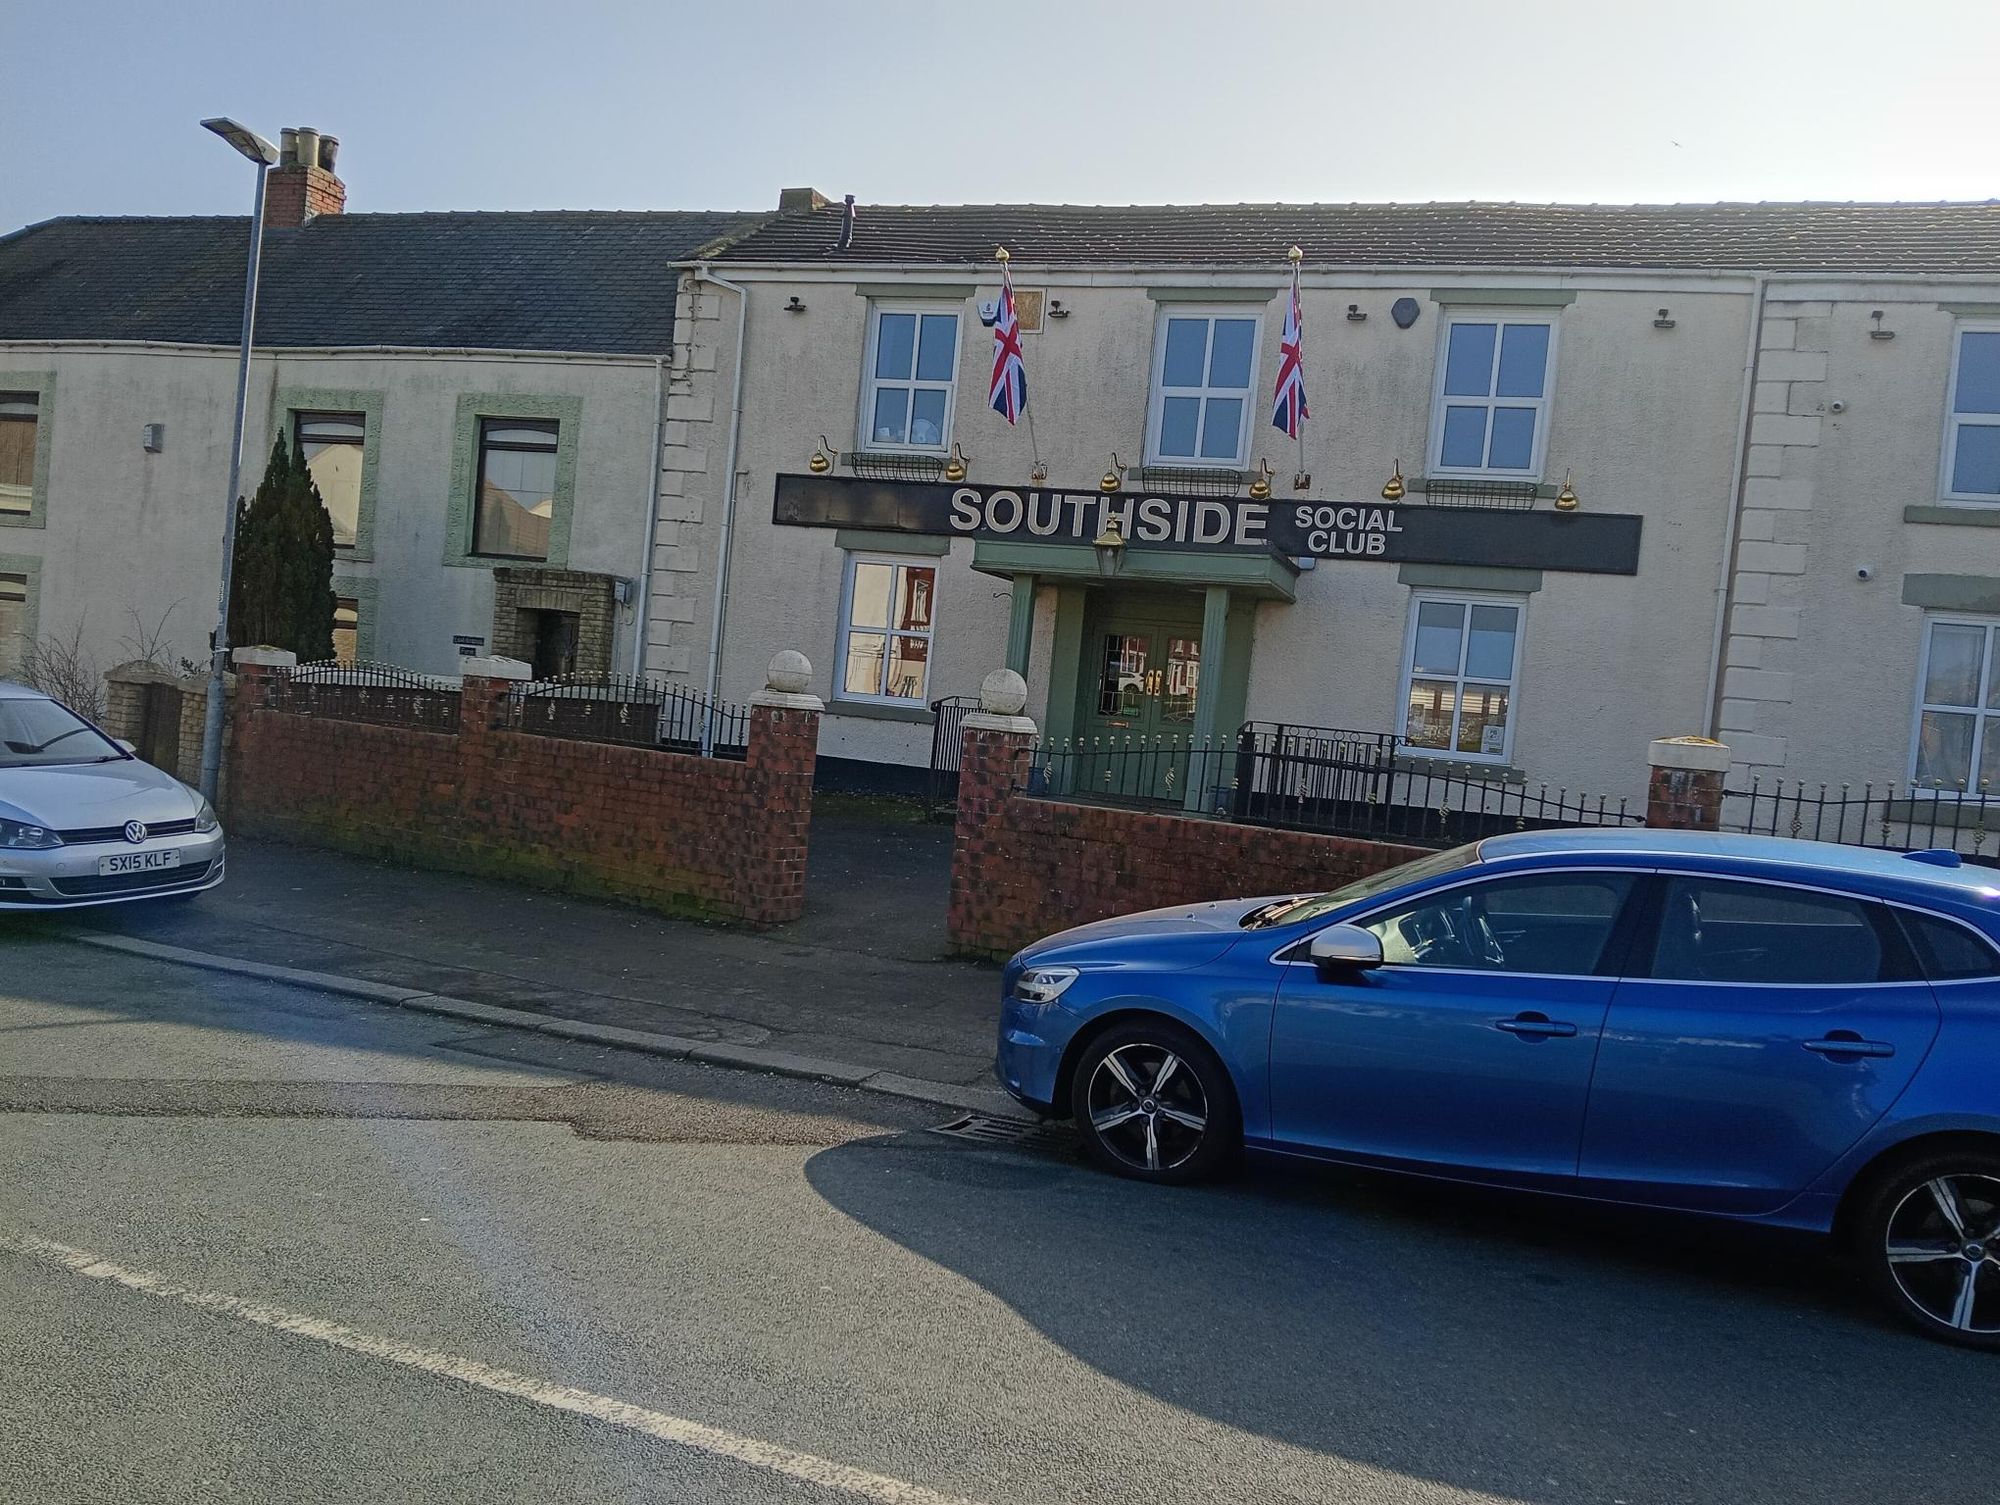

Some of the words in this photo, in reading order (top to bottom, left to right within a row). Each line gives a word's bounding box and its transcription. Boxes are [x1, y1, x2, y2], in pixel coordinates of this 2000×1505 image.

[950, 488, 1270, 546] SOUTHSIDE
[1295, 505, 1403, 532] SOCIAL
[1307, 530, 1386, 555] CLUB
[109, 855, 141, 872] SX15
[145, 851, 172, 868] KLF
